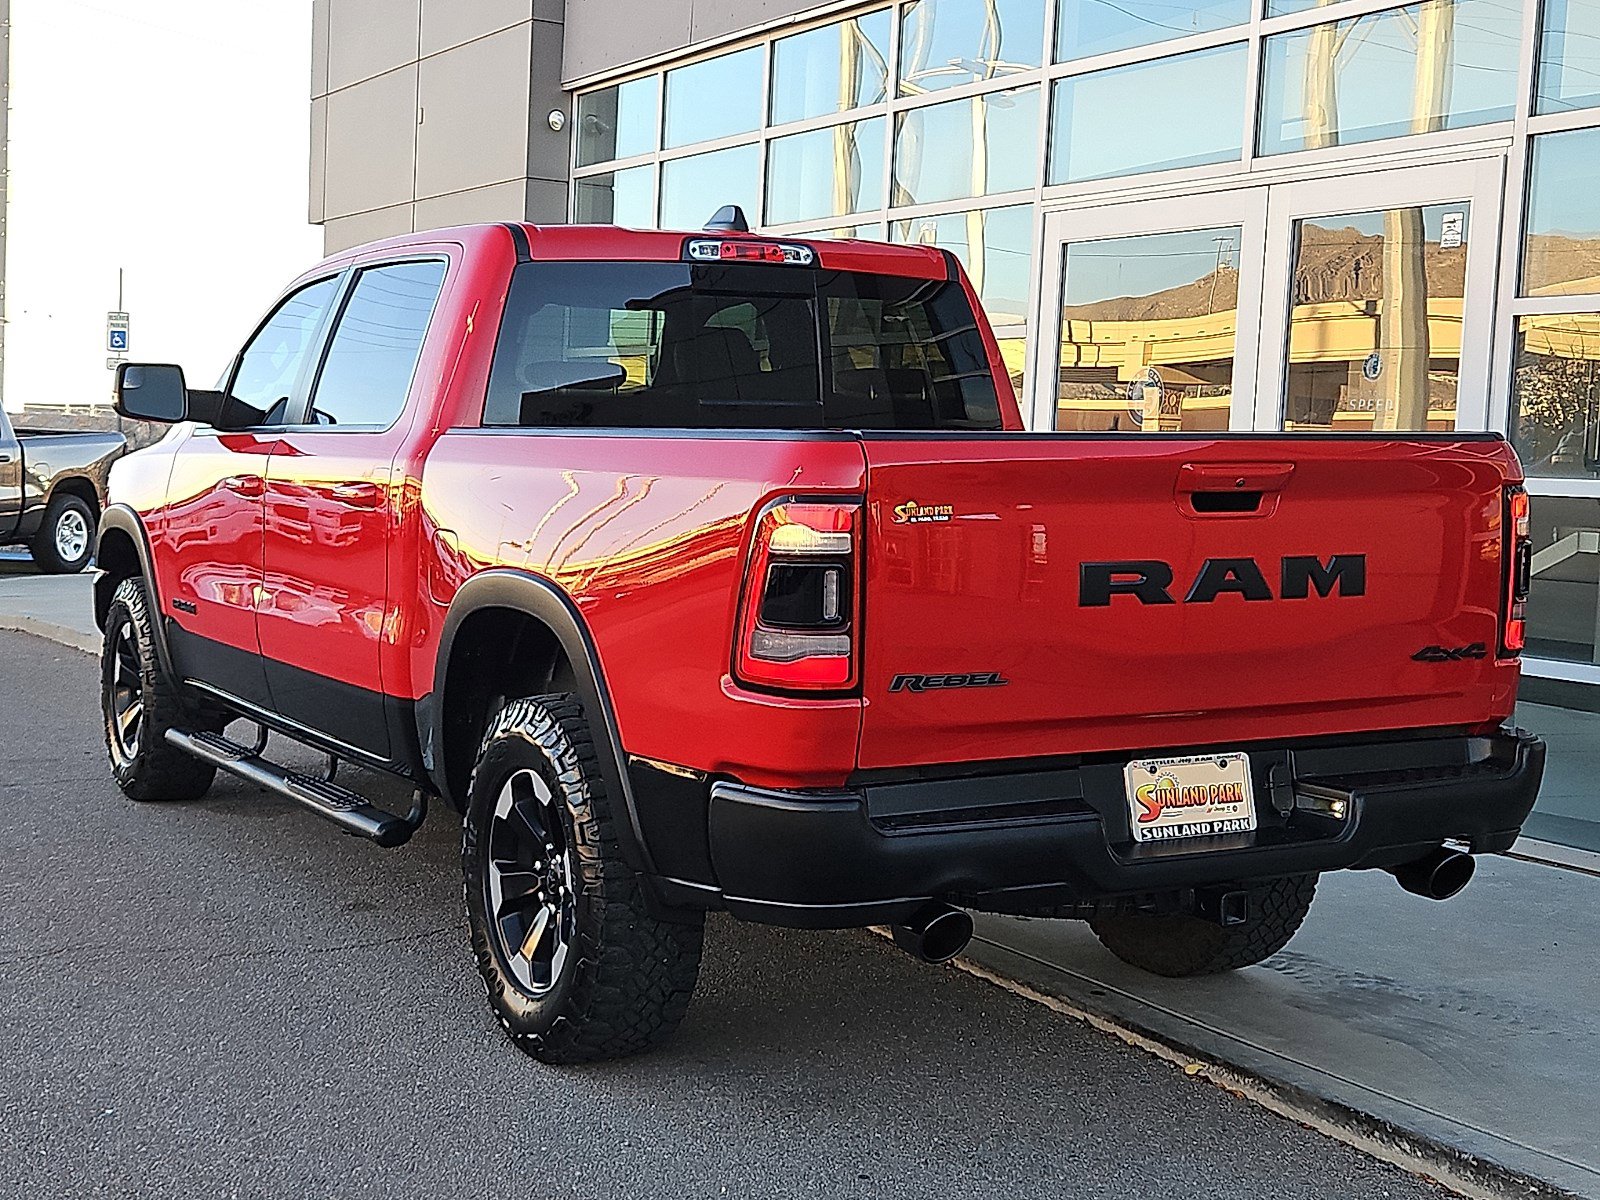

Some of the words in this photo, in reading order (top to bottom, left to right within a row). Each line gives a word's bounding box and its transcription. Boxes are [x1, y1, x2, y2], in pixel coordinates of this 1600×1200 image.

[894, 504, 935, 523] SUNLAND
[934, 505, 954, 516] PARK
[1079, 553, 1367, 607] RAM
[888, 673, 1009, 693] REBEL
[1142, 759, 1176, 767] CHRYSLER
[1136, 783, 1210, 824] SUNLAND
[1208, 782, 1244, 807] PARK
[1141, 822, 1211, 840] SUNLAND
[1212, 818, 1250, 834] PARK
